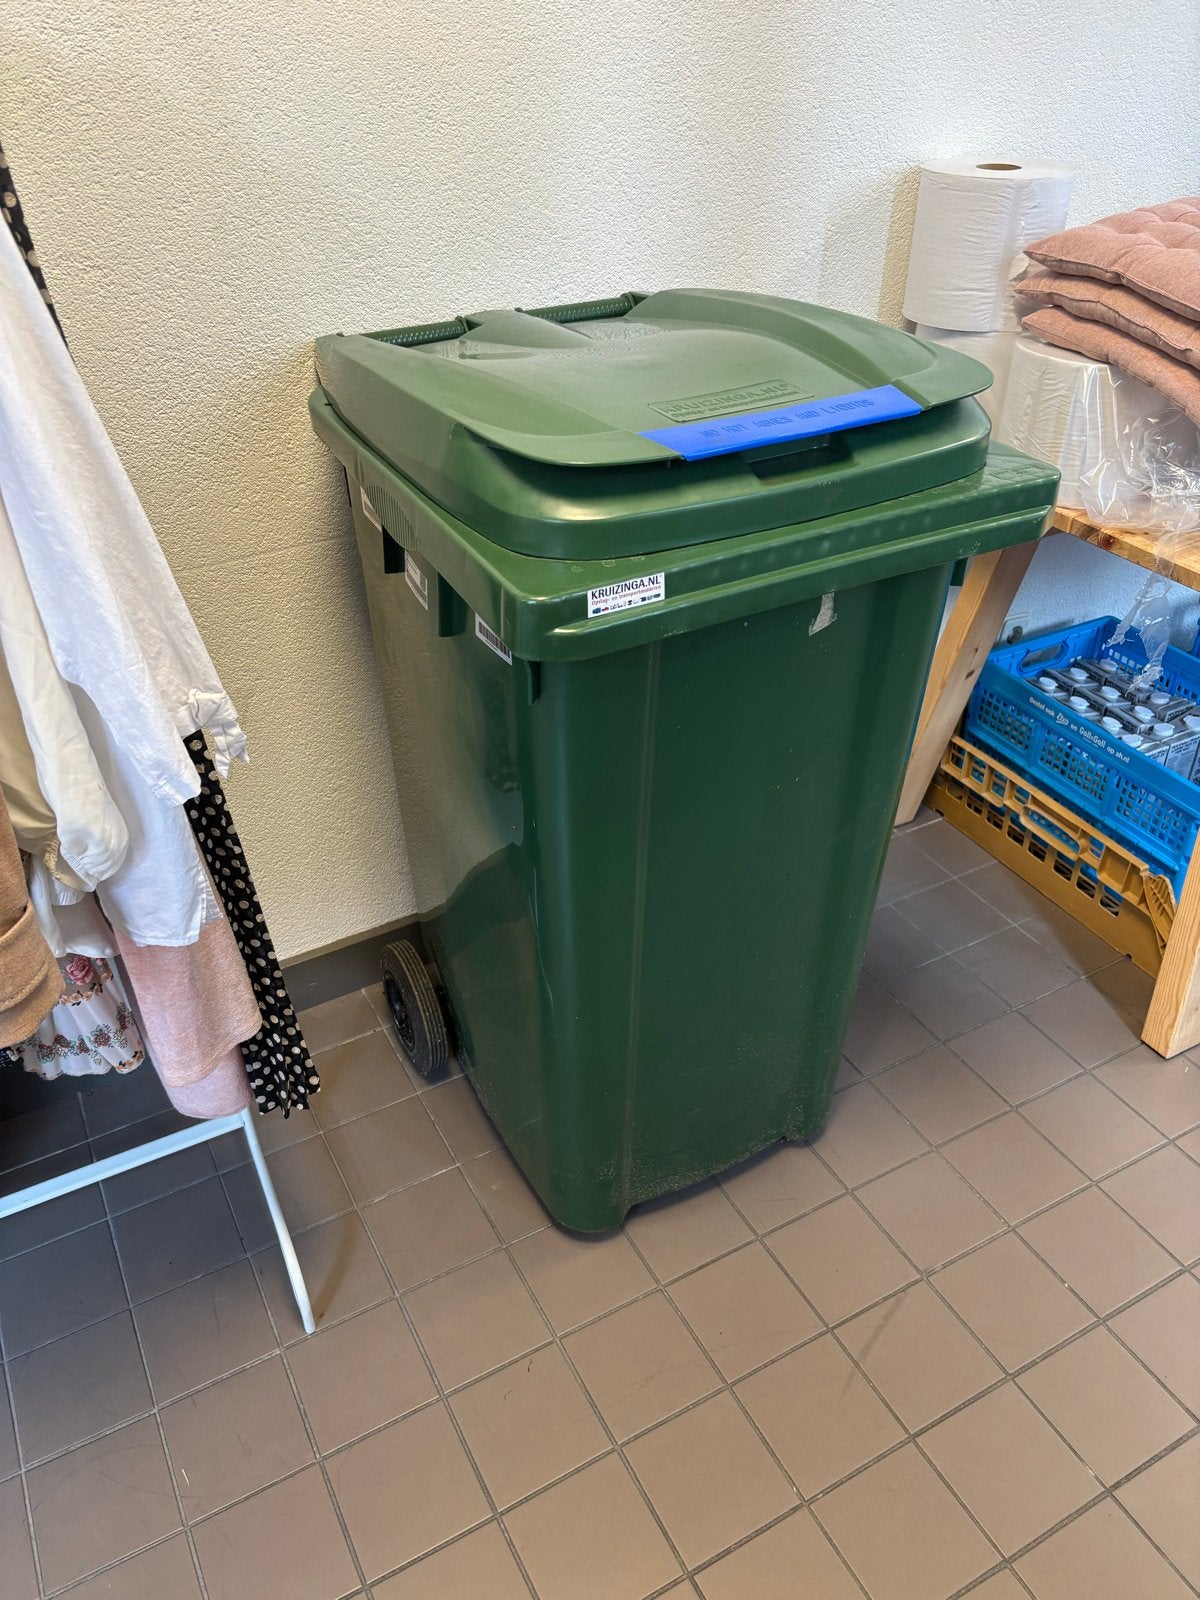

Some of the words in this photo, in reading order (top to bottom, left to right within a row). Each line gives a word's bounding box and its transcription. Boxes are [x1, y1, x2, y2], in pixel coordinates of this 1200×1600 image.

[700, 428, 720, 438] NO
[721, 423, 749, 434] HOT
[752, 416, 793, 429] ASHES
[795, 410, 821, 420] AND
[822, 399, 875, 415] LIQUIDS
[618, 585, 662, 599] transportmiddelen
[1029, 696, 1046, 711] Bestel
[1044, 706, 1055, 718] ook
[1070, 723, 1078, 732] en
[1106, 745, 1115, 755] op
[1115, 750, 1130, 764] ah.nl
